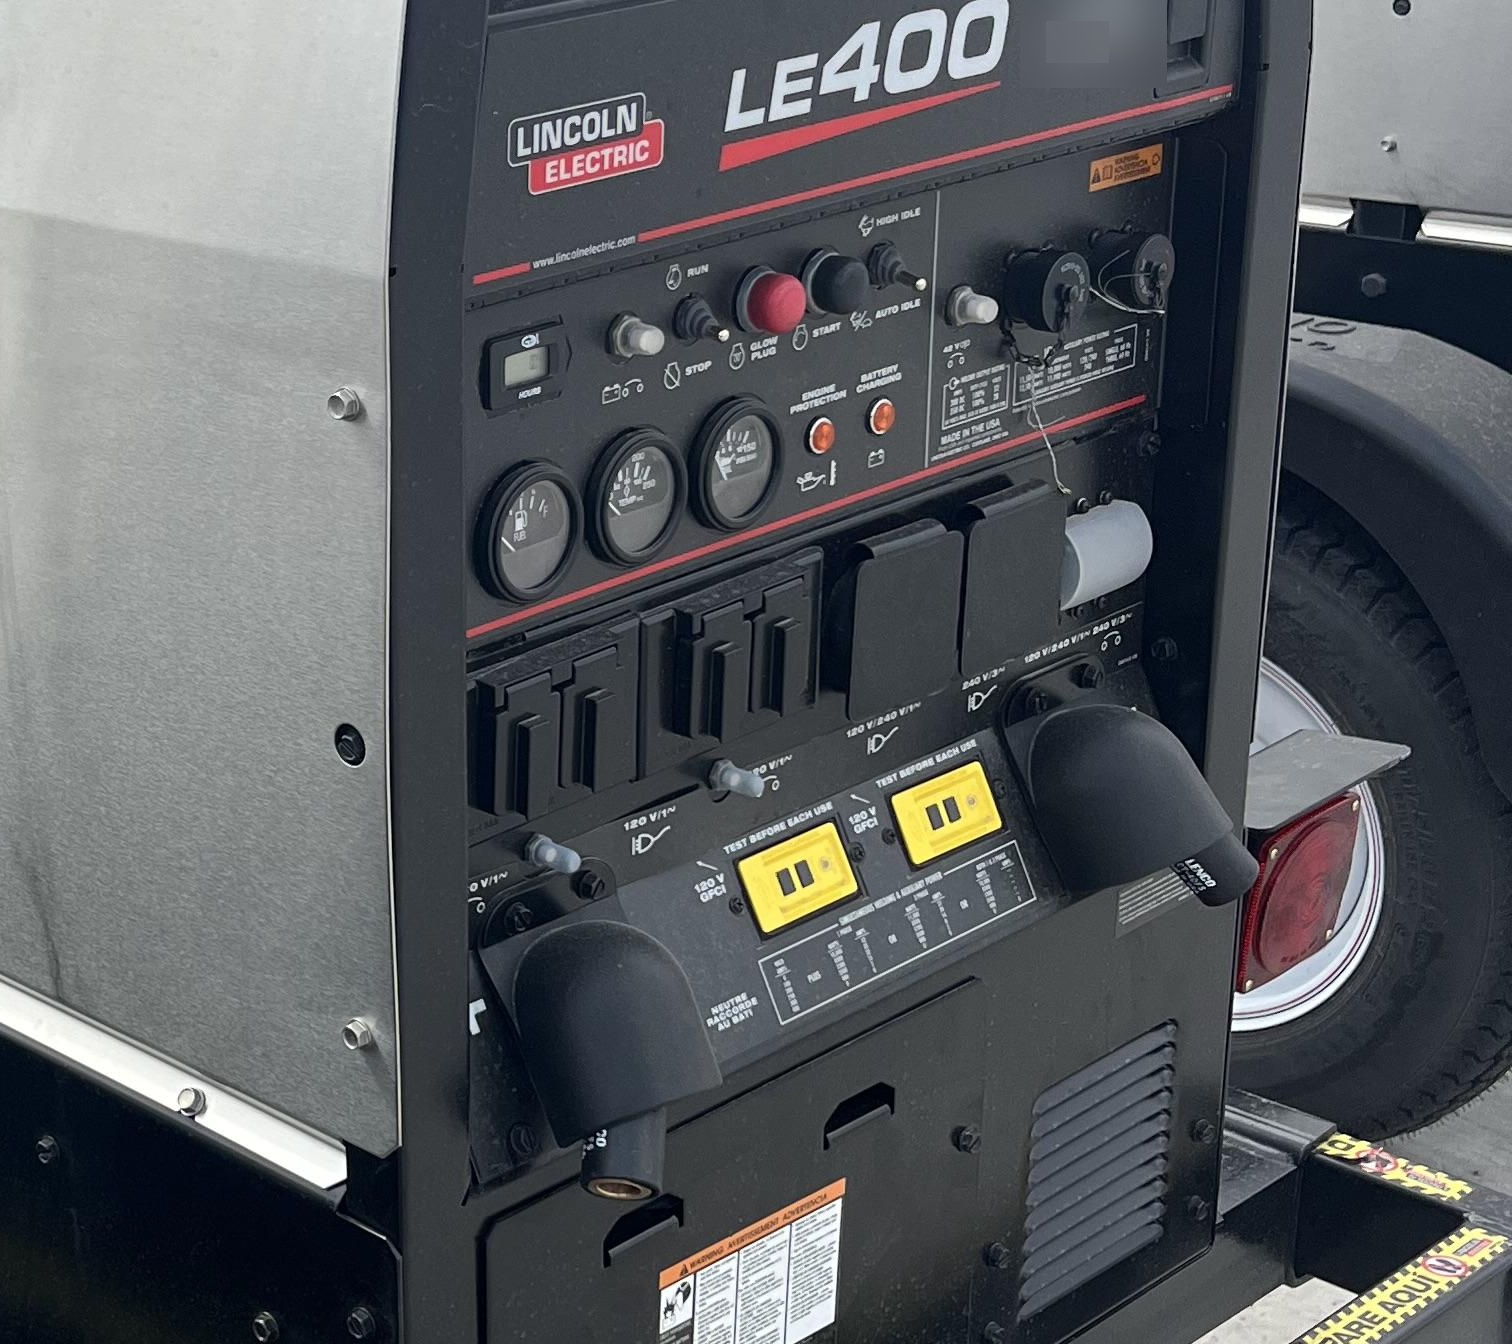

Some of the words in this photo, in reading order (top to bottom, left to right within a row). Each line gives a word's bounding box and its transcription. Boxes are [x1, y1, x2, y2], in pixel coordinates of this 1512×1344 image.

[517, 102, 637, 157] LINCOLN
[545, 139, 650, 184] ELECTRIC
[876, 214, 899, 227] HIGH
[899, 206, 921, 221] IDLE
[532, 235, 636, 269] www.lincolnelectric.com
[686, 263, 709, 278] RUN
[875, 305, 899, 319] AUTO
[900, 298, 921, 313] IDLE
[811, 322, 842, 338] START
[750, 336, 779, 352] GLOW
[750, 346, 777, 362] PLUG
[685, 360, 713, 376] STOP
[860, 364, 899, 383] BATTERY
[801, 383, 836, 401] ENGINE
[855, 372, 902, 394] CHARGING
[518, 386, 542, 400] HOURS
[790, 389, 847, 415] PROTECTION
[940, 430, 962, 445] MADE
[961, 426, 971, 438] IN
[970, 422, 985, 435] THE
[985, 418, 1001, 430] USA
[1092, 621, 1110, 635] 240
[1024, 649, 1041, 664] 120
[961, 674, 981, 691] 240
[846, 724, 865, 738] 120
[875, 772, 898, 789] TEST
[899, 757, 935, 779] BEFORE
[935, 747, 960, 763] EACH
[959, 739, 977, 753] USE
[624, 814, 646, 832] 120
[848, 810, 868, 826] 120
[869, 806, 877, 817] V
[722, 837, 748, 856] TEST
[748, 821, 787, 845] BEFORE
[787, 810, 815, 830] EACH
[813, 801, 834, 818] USE
[853, 818, 879, 835] GFCI
[1184, 858, 1217, 887] LENCO
[694, 876, 716, 893] 120
[716, 872, 725, 884] V
[699, 885, 727, 903] GFCI
[705, 996, 759, 1028] RACCORDE
[710, 991, 748, 1016] NEUTRE
[717, 1020, 732, 1032] AU
